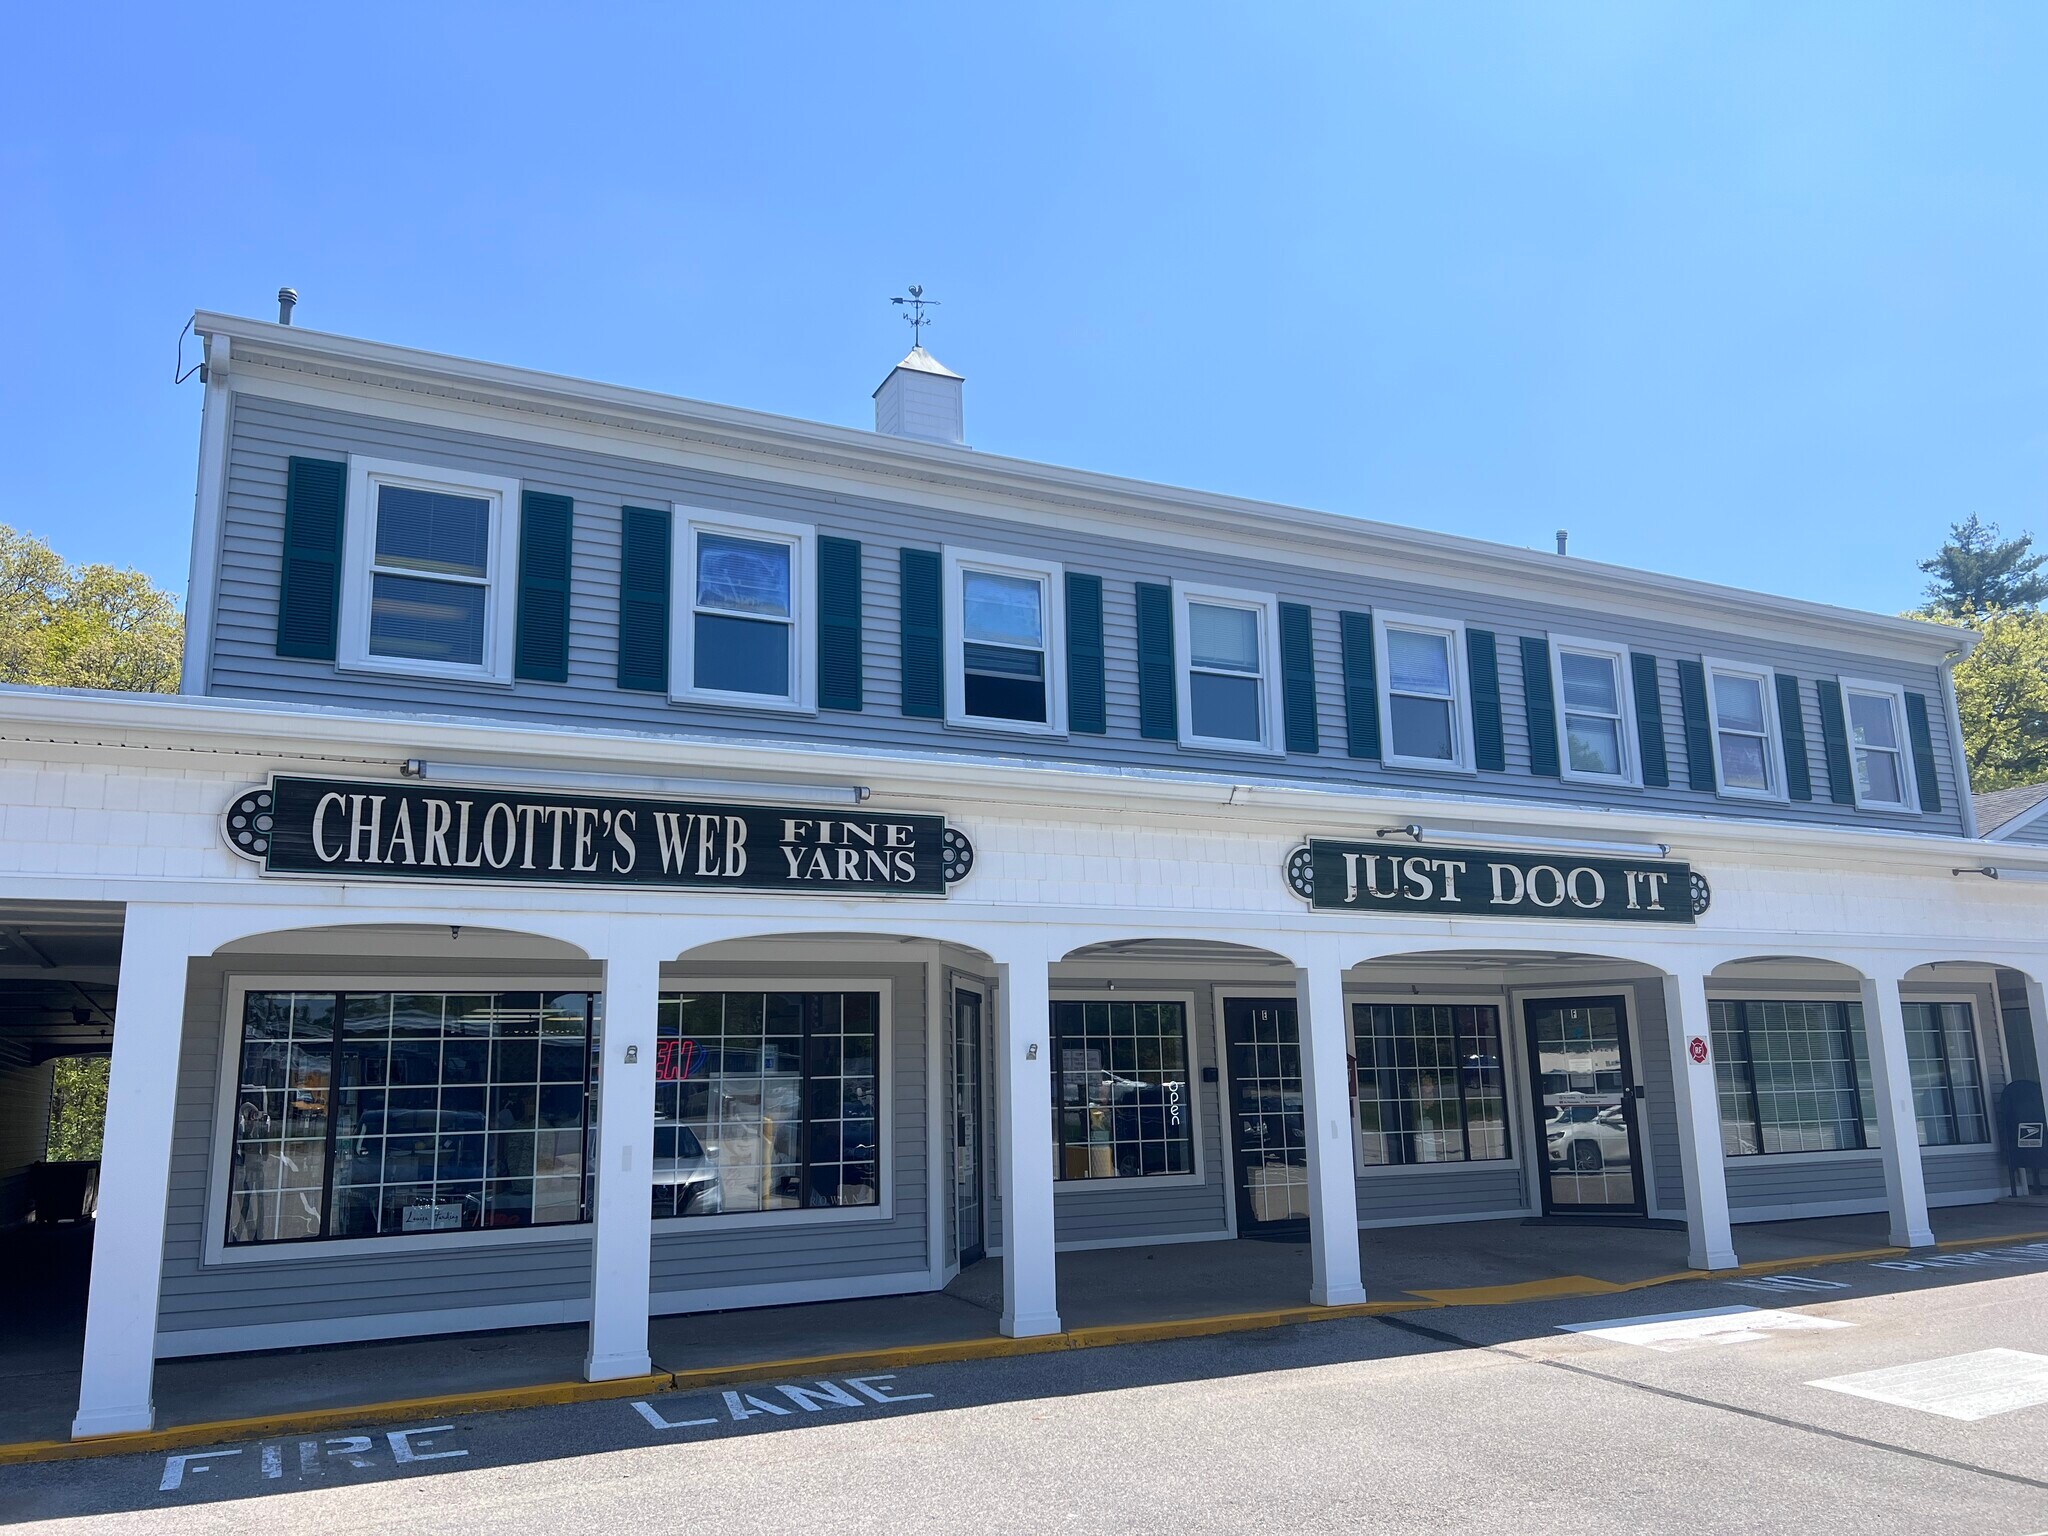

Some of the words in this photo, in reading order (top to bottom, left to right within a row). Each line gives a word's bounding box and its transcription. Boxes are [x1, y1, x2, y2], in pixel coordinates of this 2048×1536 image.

[312, 791, 637, 875] CHARLOTTE'S
[652, 811, 748, 877] WEB
[779, 818, 916, 848] FINE
[779, 845, 916, 883] YARNS
[1342, 852, 1467, 903] JUST
[1487, 863, 1606, 909] DOO
[1624, 869, 1668, 911] IT
[810, 1194, 860, 1207] ROWAN
[1723, 1275, 1852, 1293] NO
[159, 1425, 469, 1491] FIRE
[630, 1374, 934, 1429] LANE
